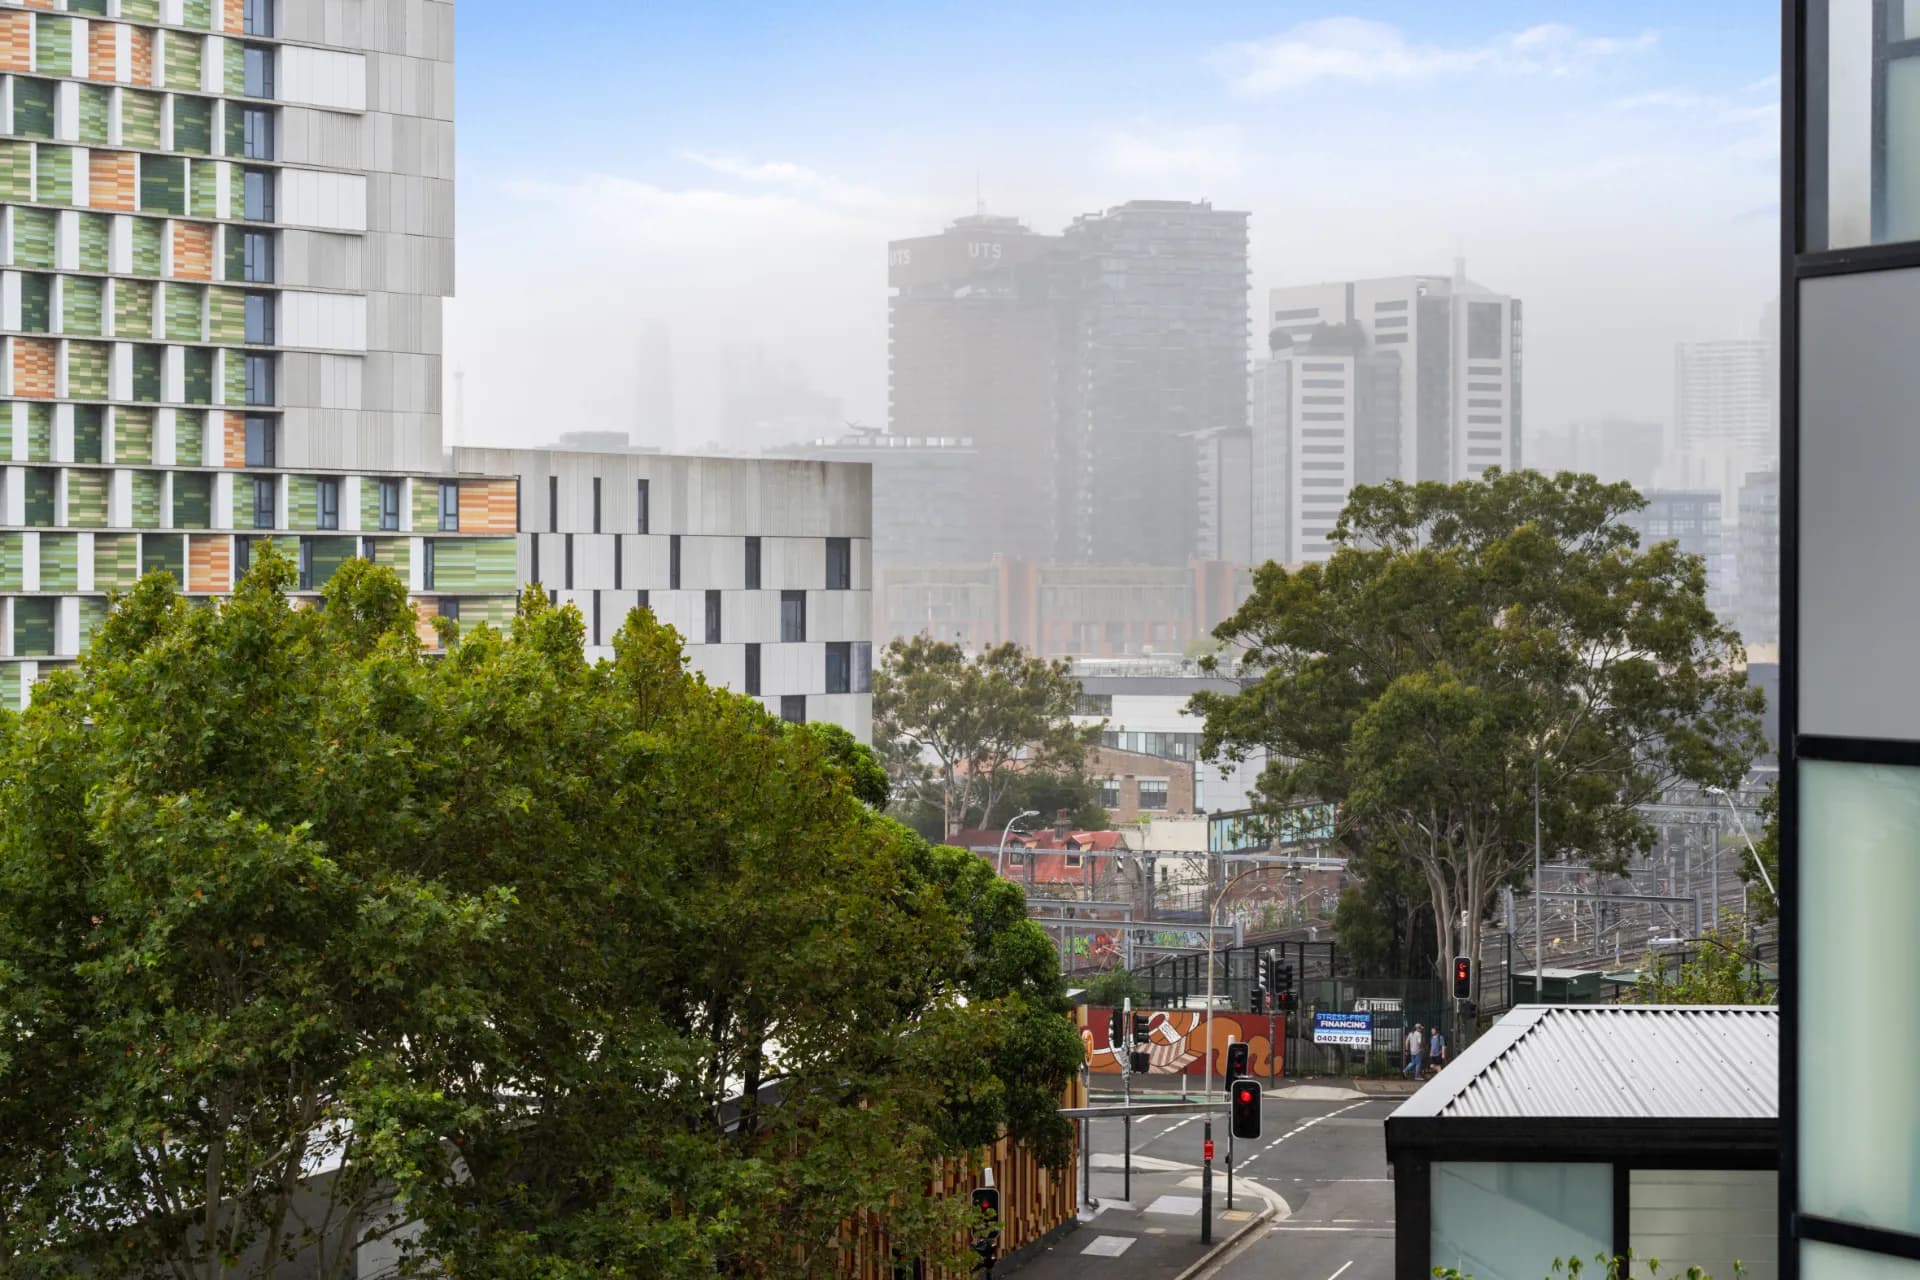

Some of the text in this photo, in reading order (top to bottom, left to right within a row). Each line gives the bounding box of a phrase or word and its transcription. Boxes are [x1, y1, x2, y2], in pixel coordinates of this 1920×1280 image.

[968, 242, 1002, 259] UTS
[1316, 1013, 1370, 1021] STRESS-FREE
[1320, 1020, 1367, 1029] FINANCING
